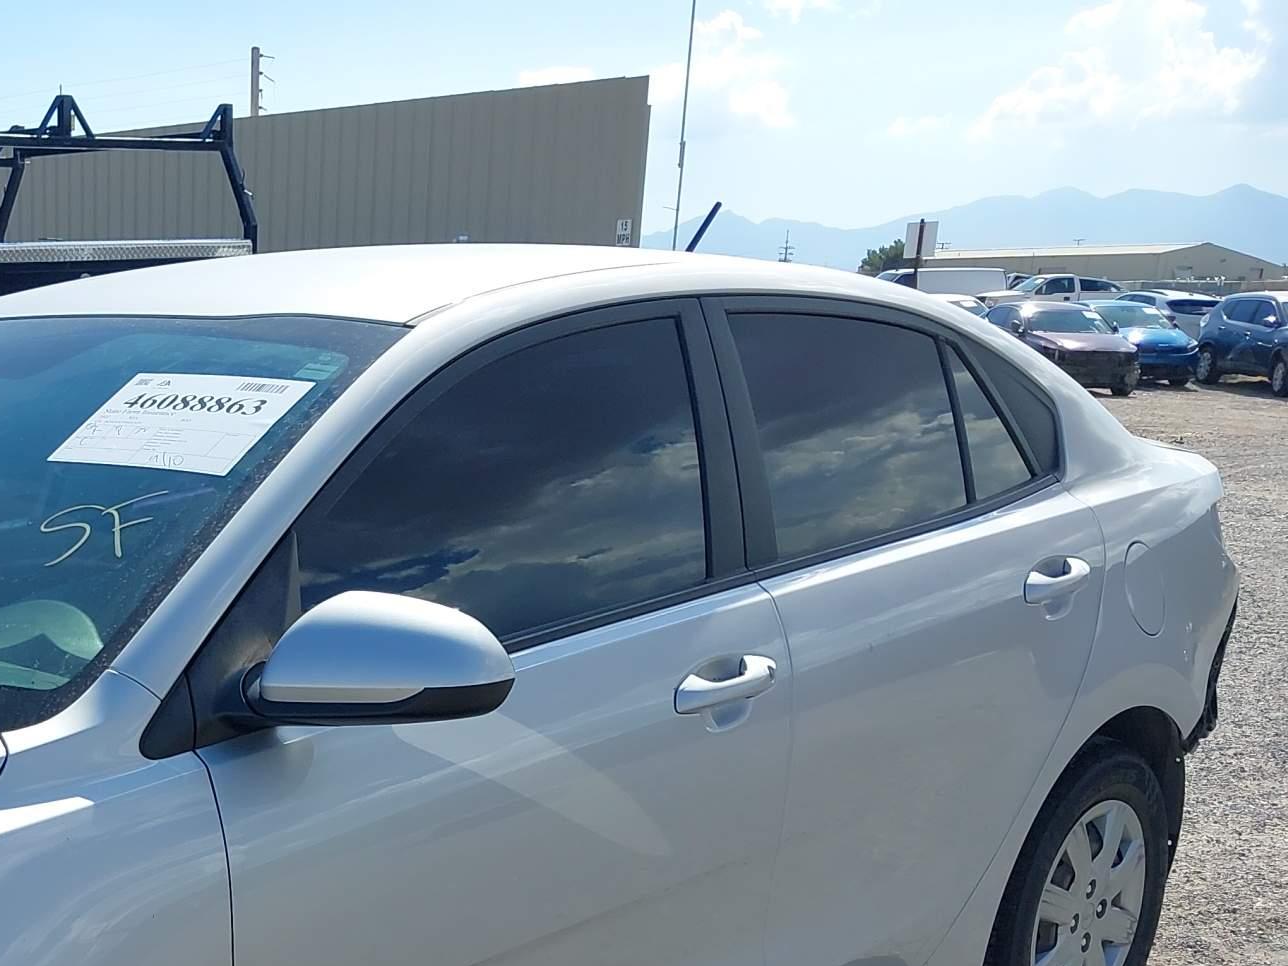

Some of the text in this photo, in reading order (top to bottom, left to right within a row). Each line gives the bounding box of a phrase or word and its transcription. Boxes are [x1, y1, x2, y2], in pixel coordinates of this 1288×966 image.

[620, 220, 629, 232] 15
[616, 233, 631, 245] MPH
[124, 392, 268, 417] 46088863
[39, 490, 169, 567] SF
